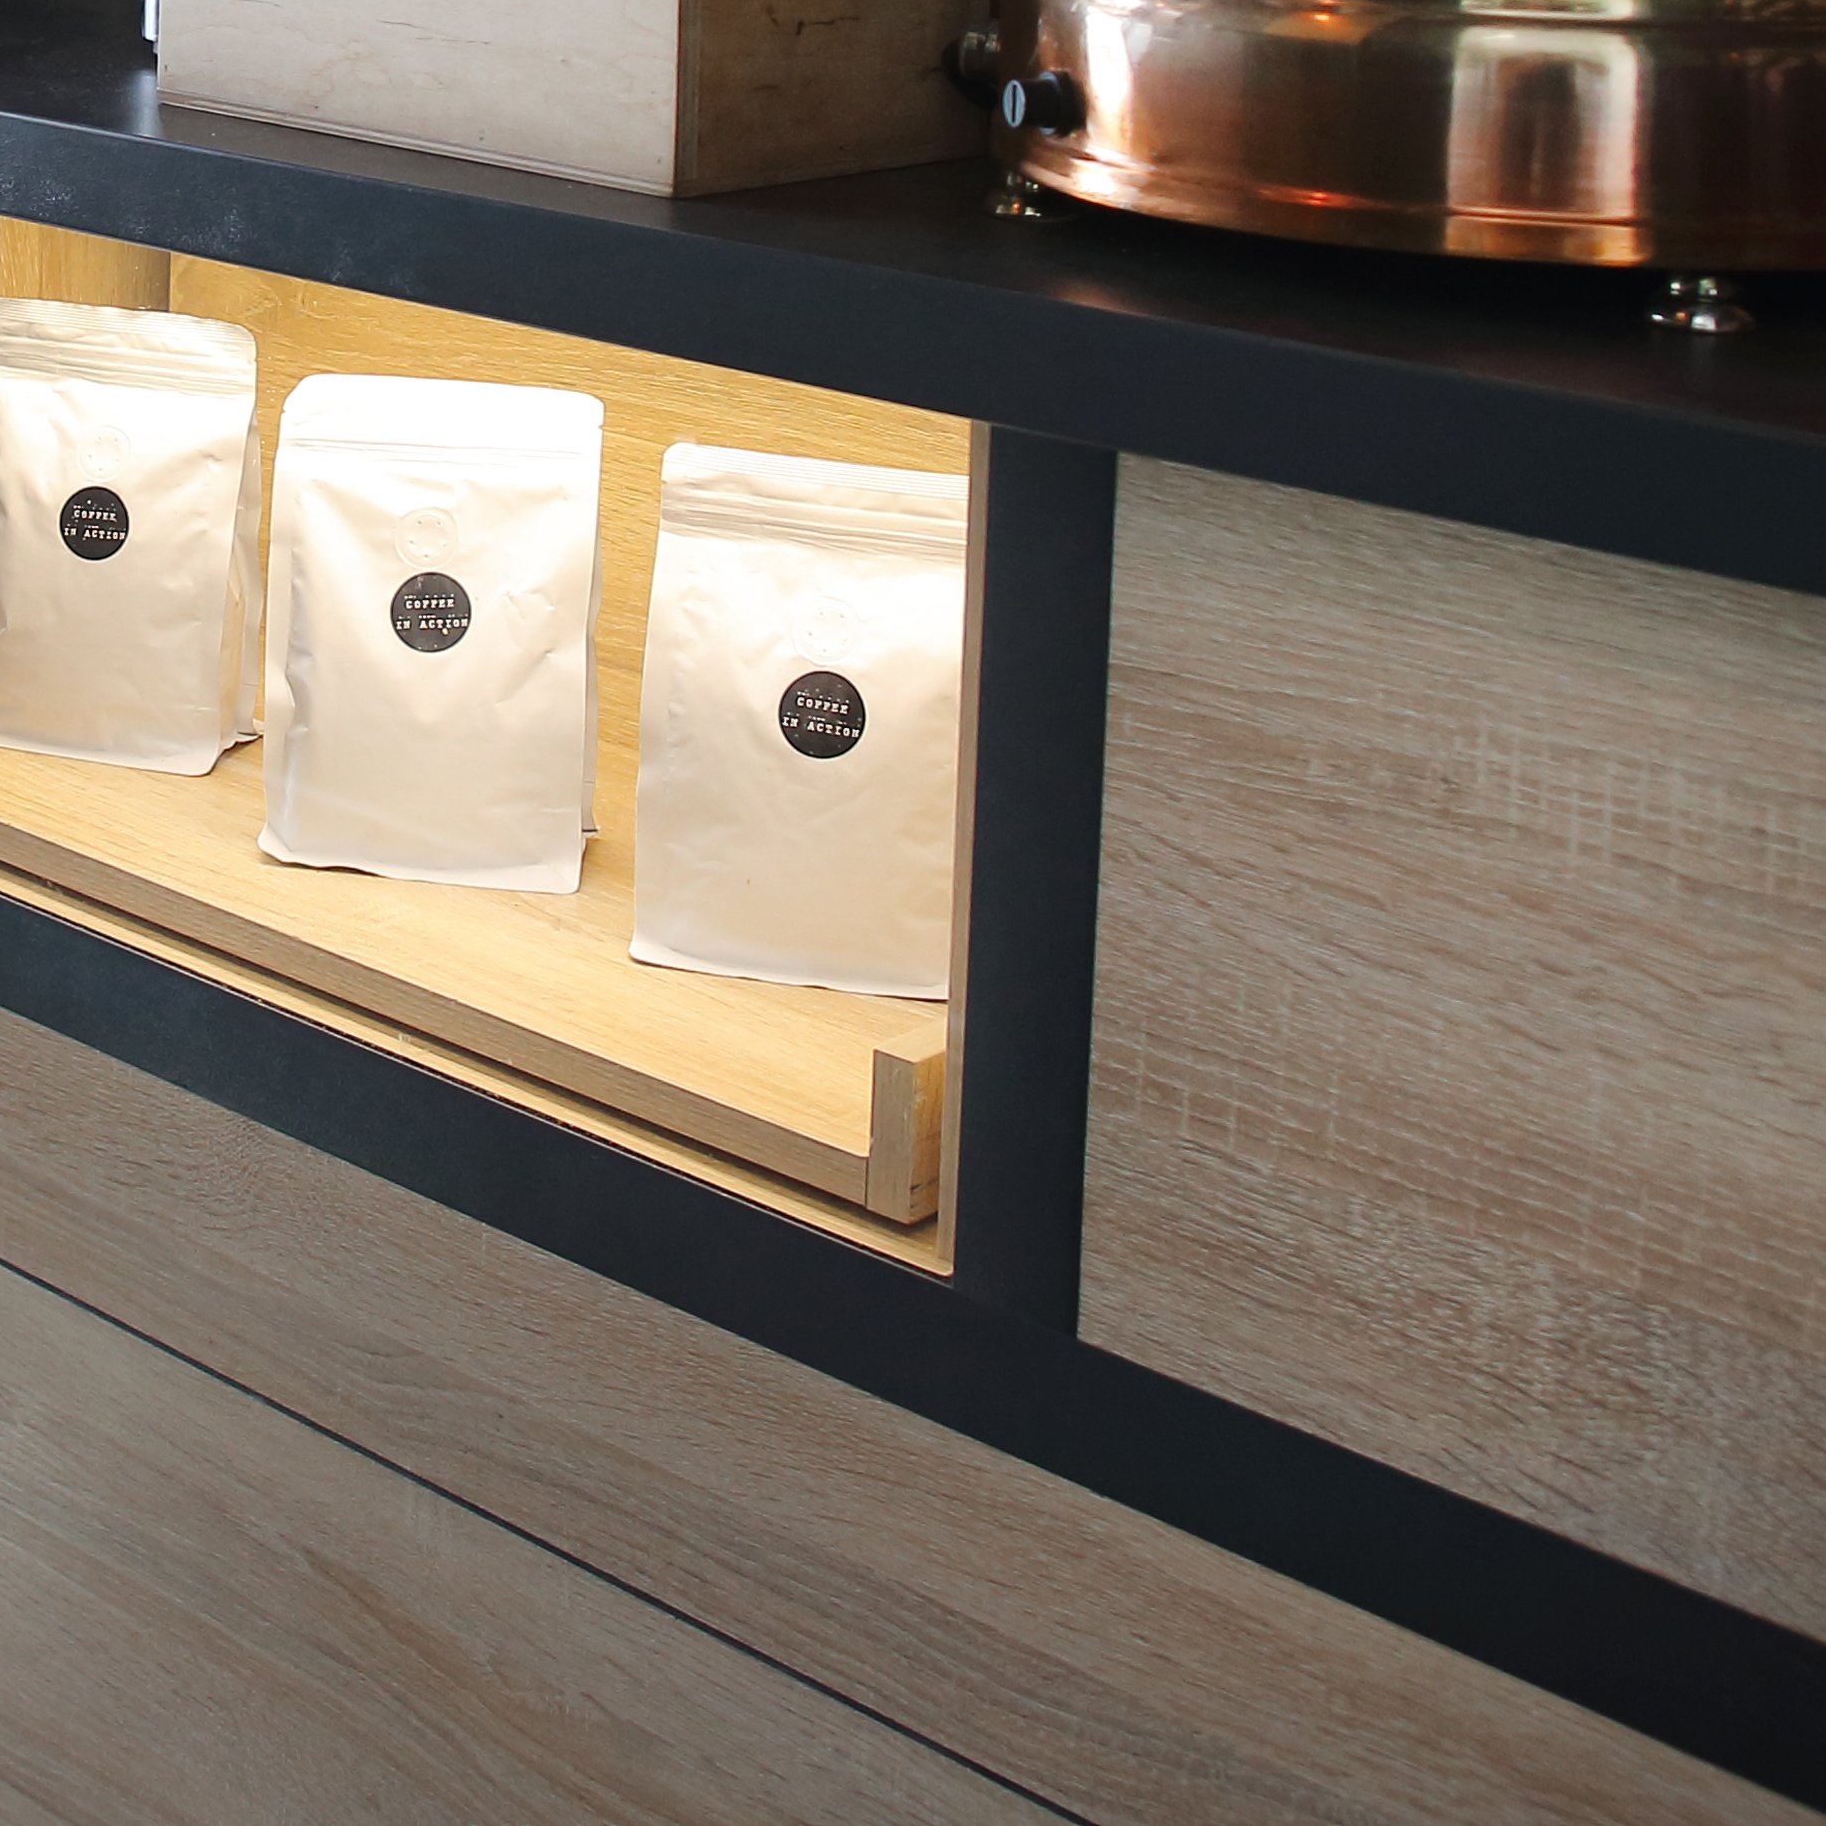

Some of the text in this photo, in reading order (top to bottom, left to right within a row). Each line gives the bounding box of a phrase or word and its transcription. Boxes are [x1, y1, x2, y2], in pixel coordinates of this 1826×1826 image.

[74, 509, 117, 522] COFFEE
[64, 527, 126, 540] IN ACTION
[405, 598, 455, 610] COFFEE
[396, 618, 469, 630] IN ACTION
[796, 696, 849, 715] COFFEE
[782, 716, 861, 738] IN ACTION
